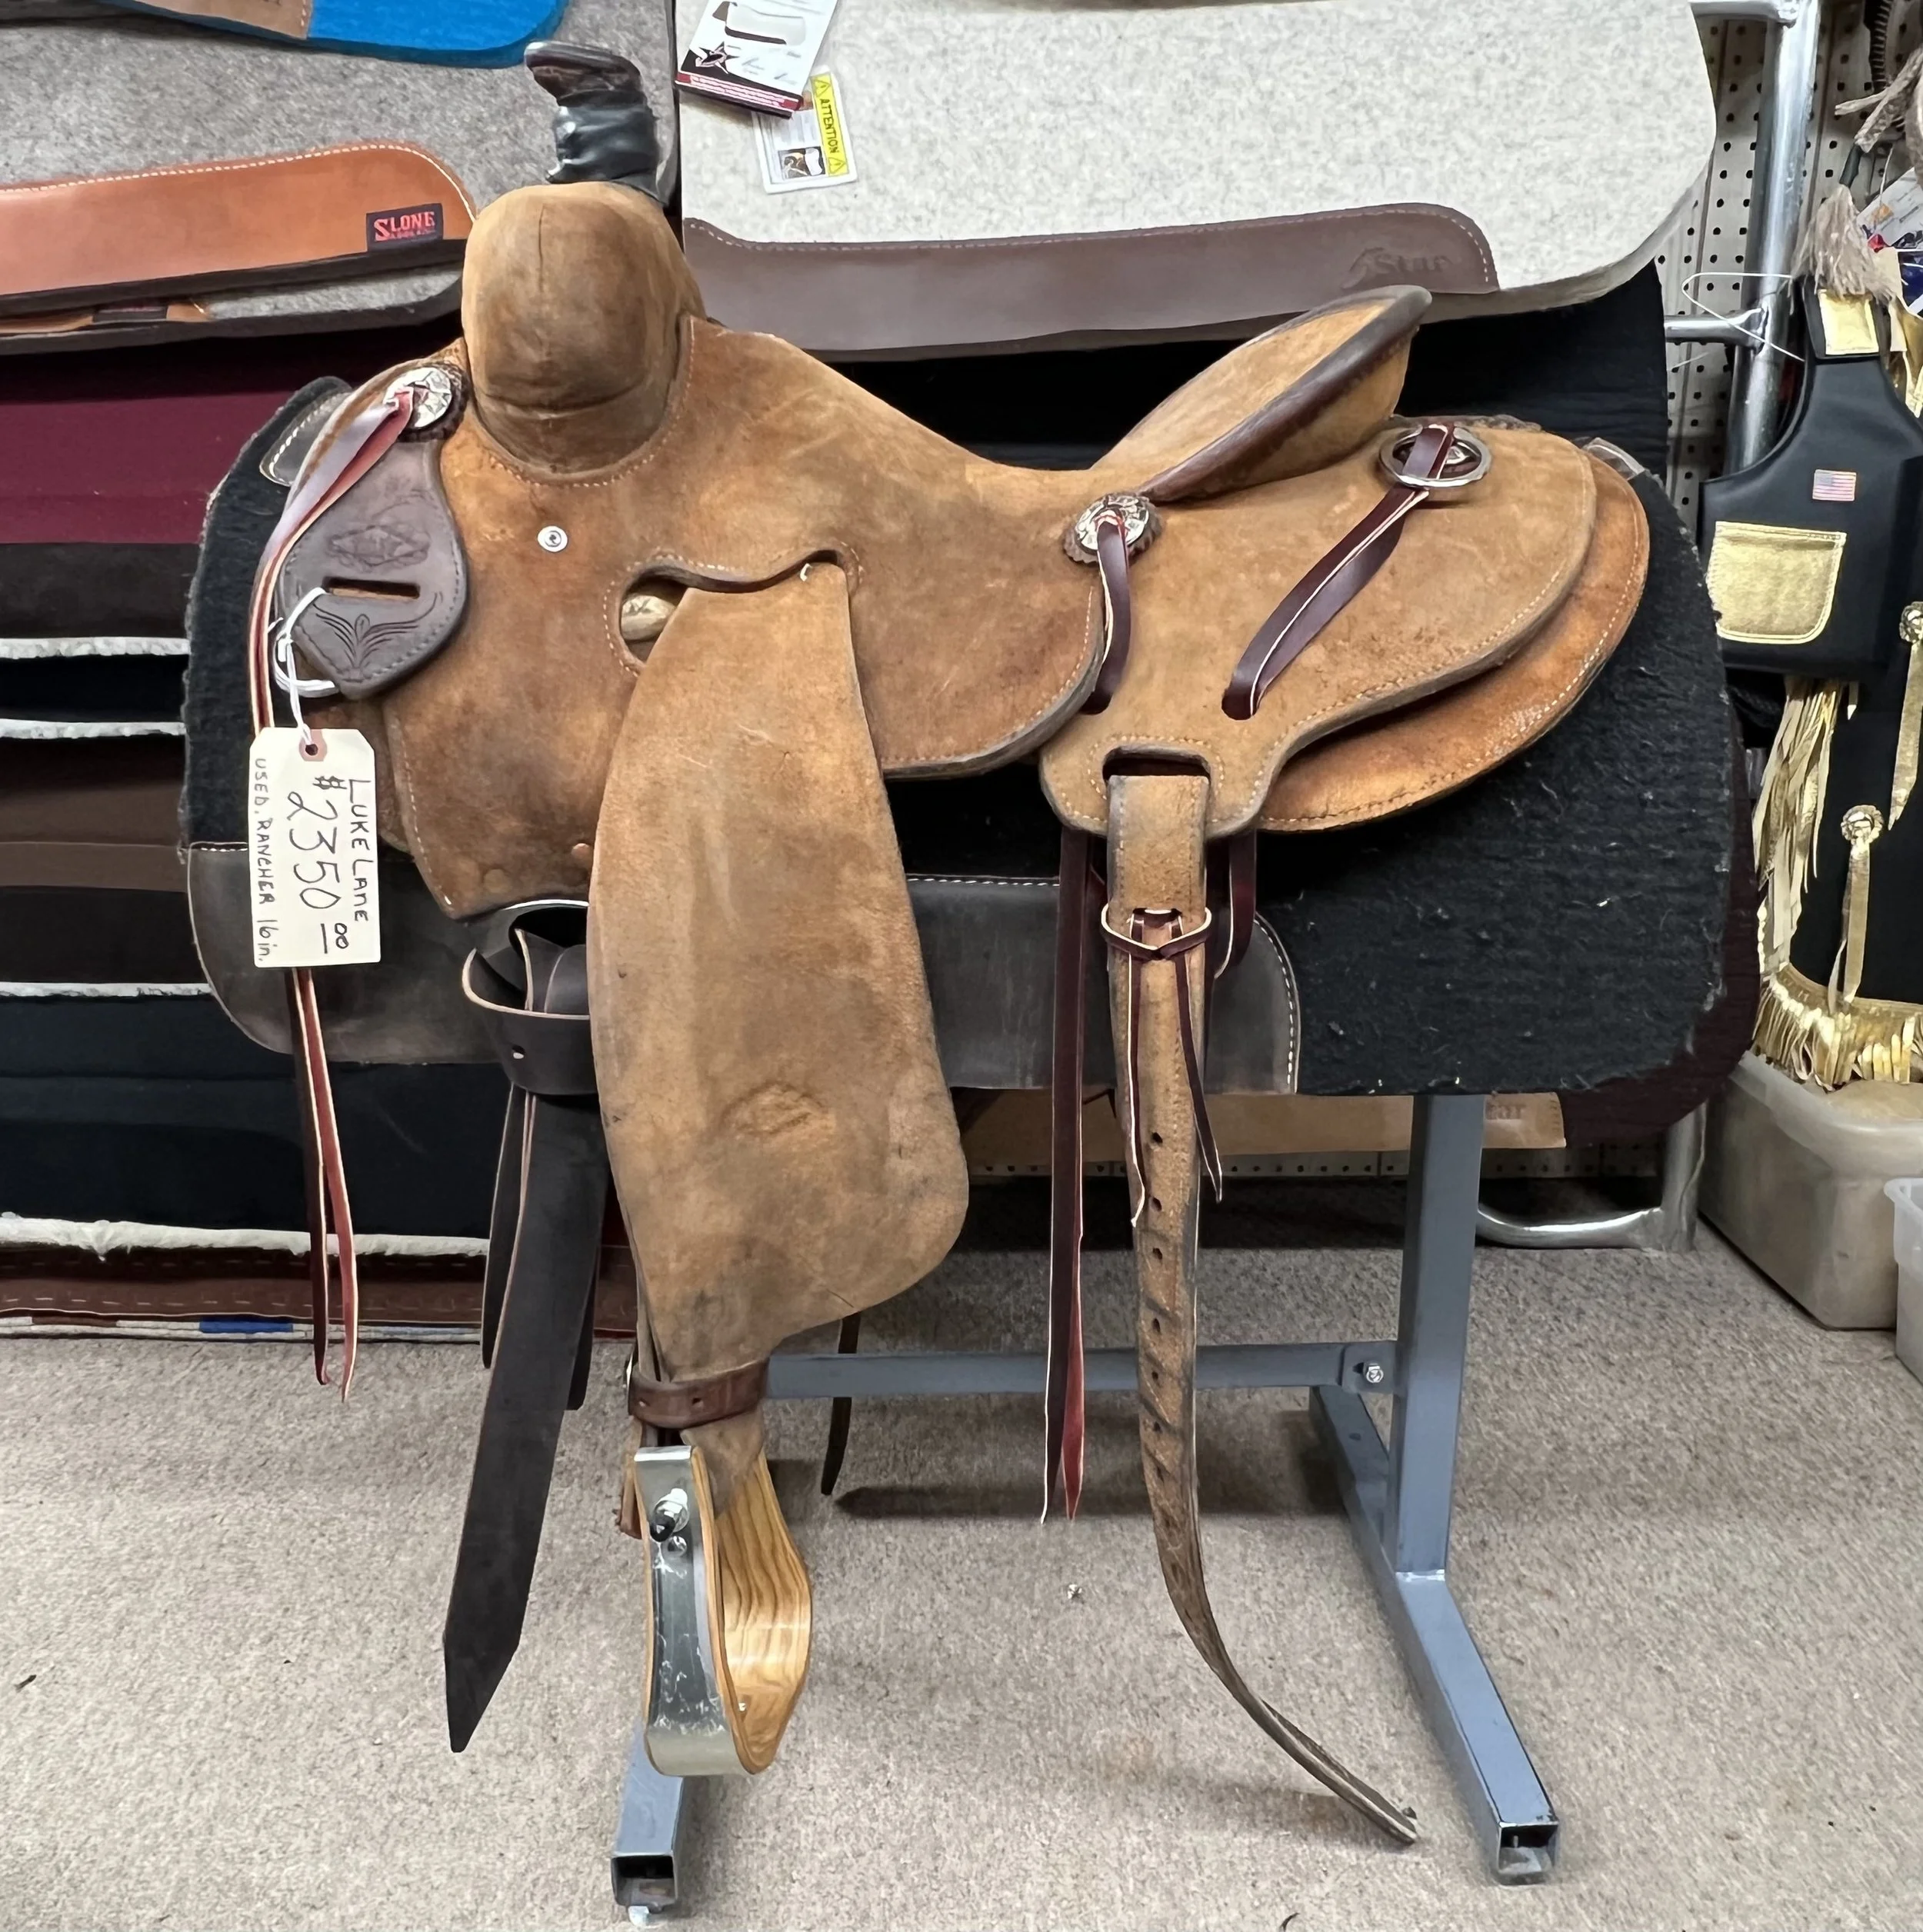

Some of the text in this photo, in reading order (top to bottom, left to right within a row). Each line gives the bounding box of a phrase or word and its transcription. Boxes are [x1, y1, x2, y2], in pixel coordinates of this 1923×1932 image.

[820, 98, 839, 154] ATTENTION
[374, 211, 435, 241] SLONE
[348, 778, 372, 851] LUKE
[256, 818, 276, 905] RANCHER
